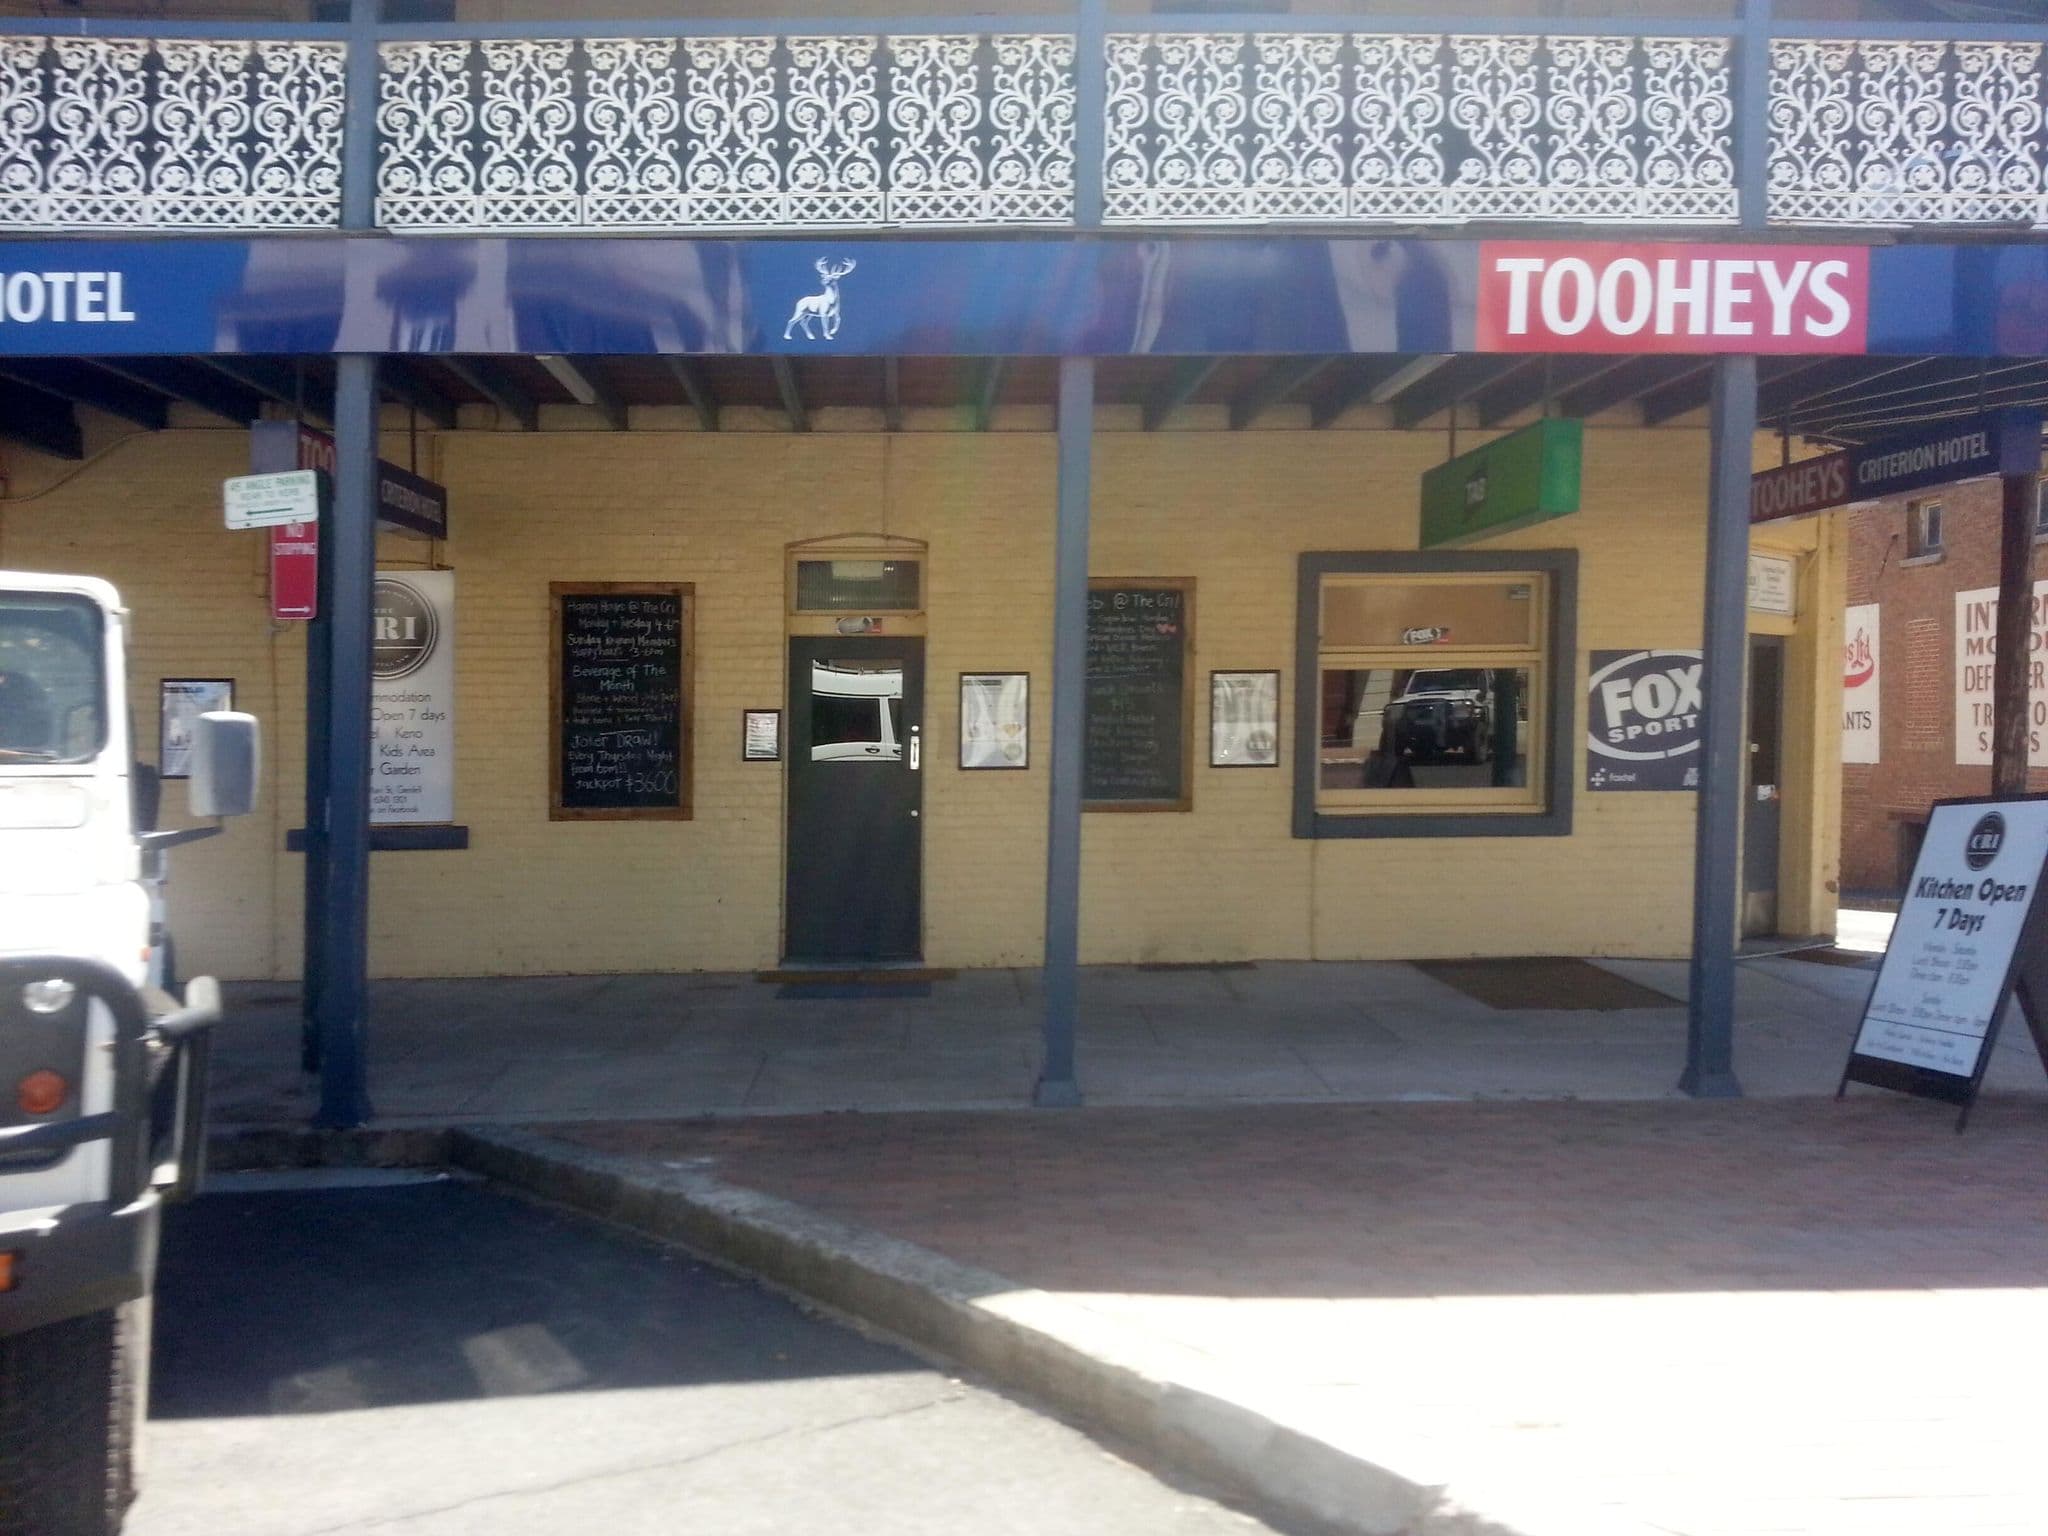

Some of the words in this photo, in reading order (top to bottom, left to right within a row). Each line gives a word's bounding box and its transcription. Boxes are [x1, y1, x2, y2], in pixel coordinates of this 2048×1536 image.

[0, 271, 136, 323] OTEL
[1495, 257, 1851, 337] TOOHEYS
[1859, 444, 1936, 484] CRITERION
[1937, 431, 1990, 467] HOTEL
[1750, 459, 1846, 517] TOOHEYS
[285, 523, 305, 538] NO
[274, 543, 317, 556] STOPPING
[1113, 592, 1129, 610] @
[1132, 593, 1153, 608] The
[374, 616, 417, 640] RI
[573, 665, 623, 681] Beverage
[627, 664, 640, 680] of
[642, 664, 667, 677] The
[600, 680, 635, 692] Month
[1601, 663, 1703, 729] FOX
[373, 690, 432, 703] mmodation
[408, 708, 417, 721] 7
[420, 706, 447, 726] days
[395, 726, 424, 740] Keno
[1607, 713, 1699, 744] SPORT
[380, 744, 404, 757] Kids
[408, 744, 436, 757] Area
[380, 761, 422, 776] Garden
[1914, 876, 1974, 900] Kitchen
[1978, 876, 2028, 906] Open
[1933, 908, 1944, 928] 7
[1949, 908, 1986, 937] Days
